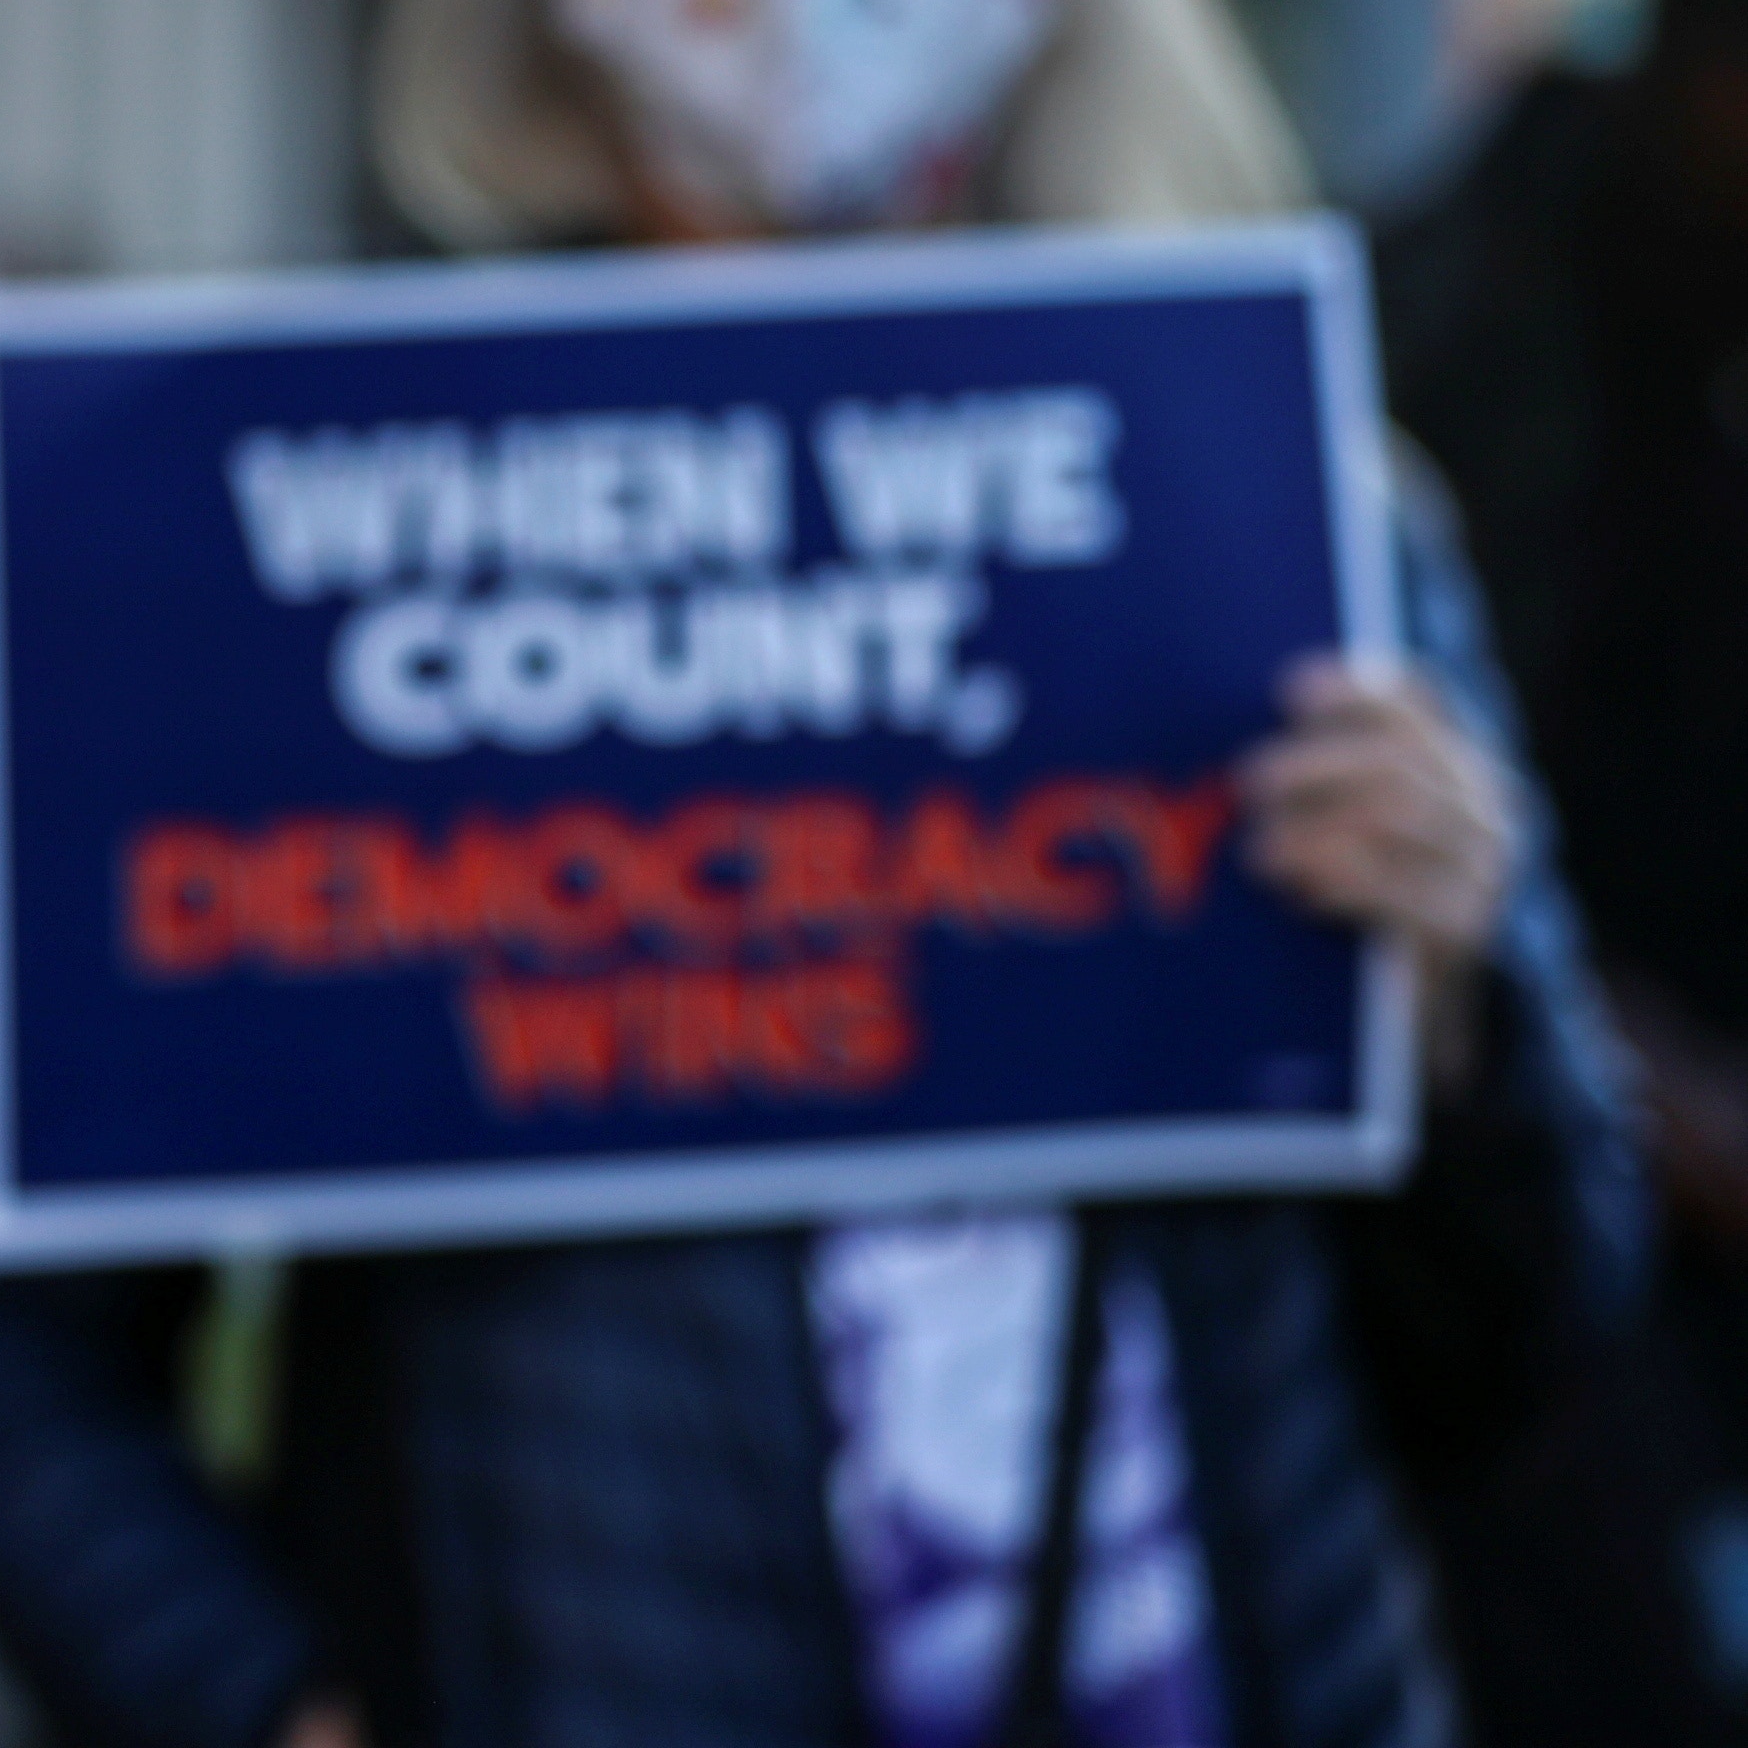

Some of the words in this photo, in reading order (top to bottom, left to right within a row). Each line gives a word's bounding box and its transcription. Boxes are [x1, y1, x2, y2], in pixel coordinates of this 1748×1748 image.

[231, 402, 790, 600] WHEN
[816, 386, 1124, 566] WE
[332, 564, 1020, 756] COUNT,
[126, 772, 1240, 976] DEMOCRACY
[466, 954, 918, 1108] WINS
